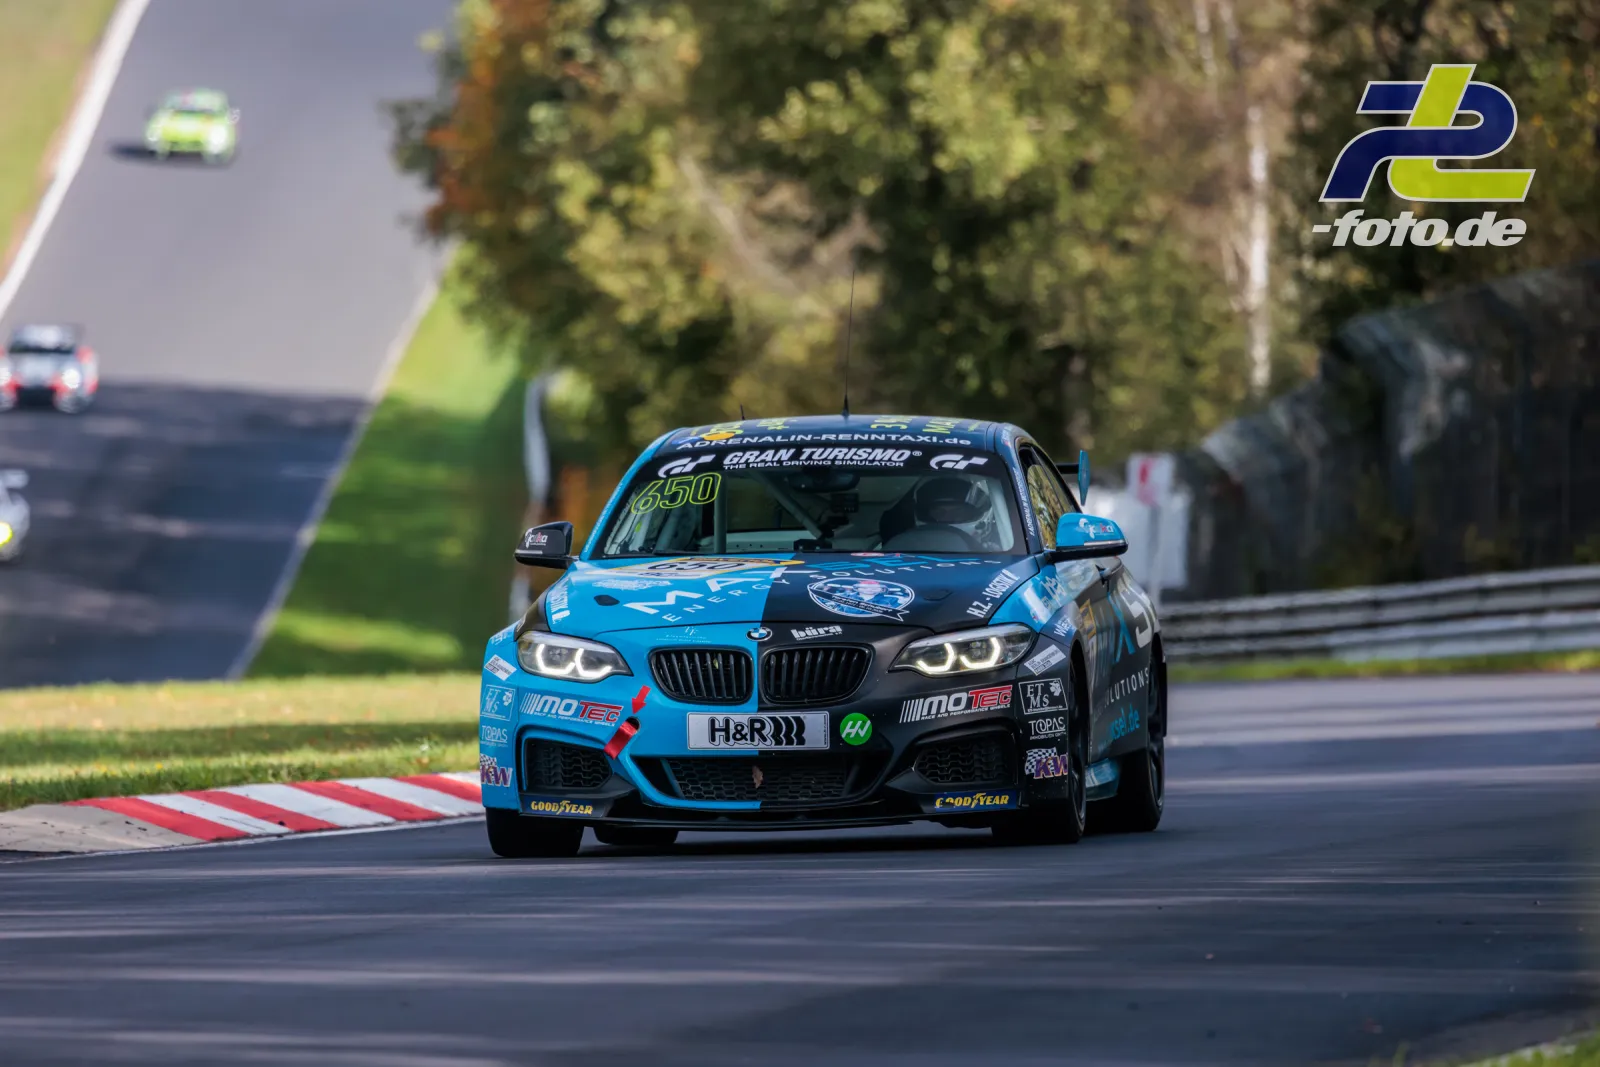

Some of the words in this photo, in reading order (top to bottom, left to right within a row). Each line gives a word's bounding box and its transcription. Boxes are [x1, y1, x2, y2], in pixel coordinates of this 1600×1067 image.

[676, 434, 971, 449] ADRENALIN-RENNTAXI.de
[722, 448, 796, 465] GRAN
[631, 472, 721, 515] 650
[648, 561, 745, 571] 650
[661, 577, 791, 622] ENERGY
[1026, 683, 1044, 697] ET
[535, 695, 624, 723] MOTEC
[921, 685, 1013, 716] MOTEC
[1030, 694, 1050, 709] MS
[482, 725, 508, 743] TOPAS
[708, 716, 773, 746] H&R
[1028, 716, 1066, 735] TOPAS
[1033, 753, 1069, 779] KW
[480, 764, 513, 788] KW
[531, 800, 593, 815] GOODYEAR
